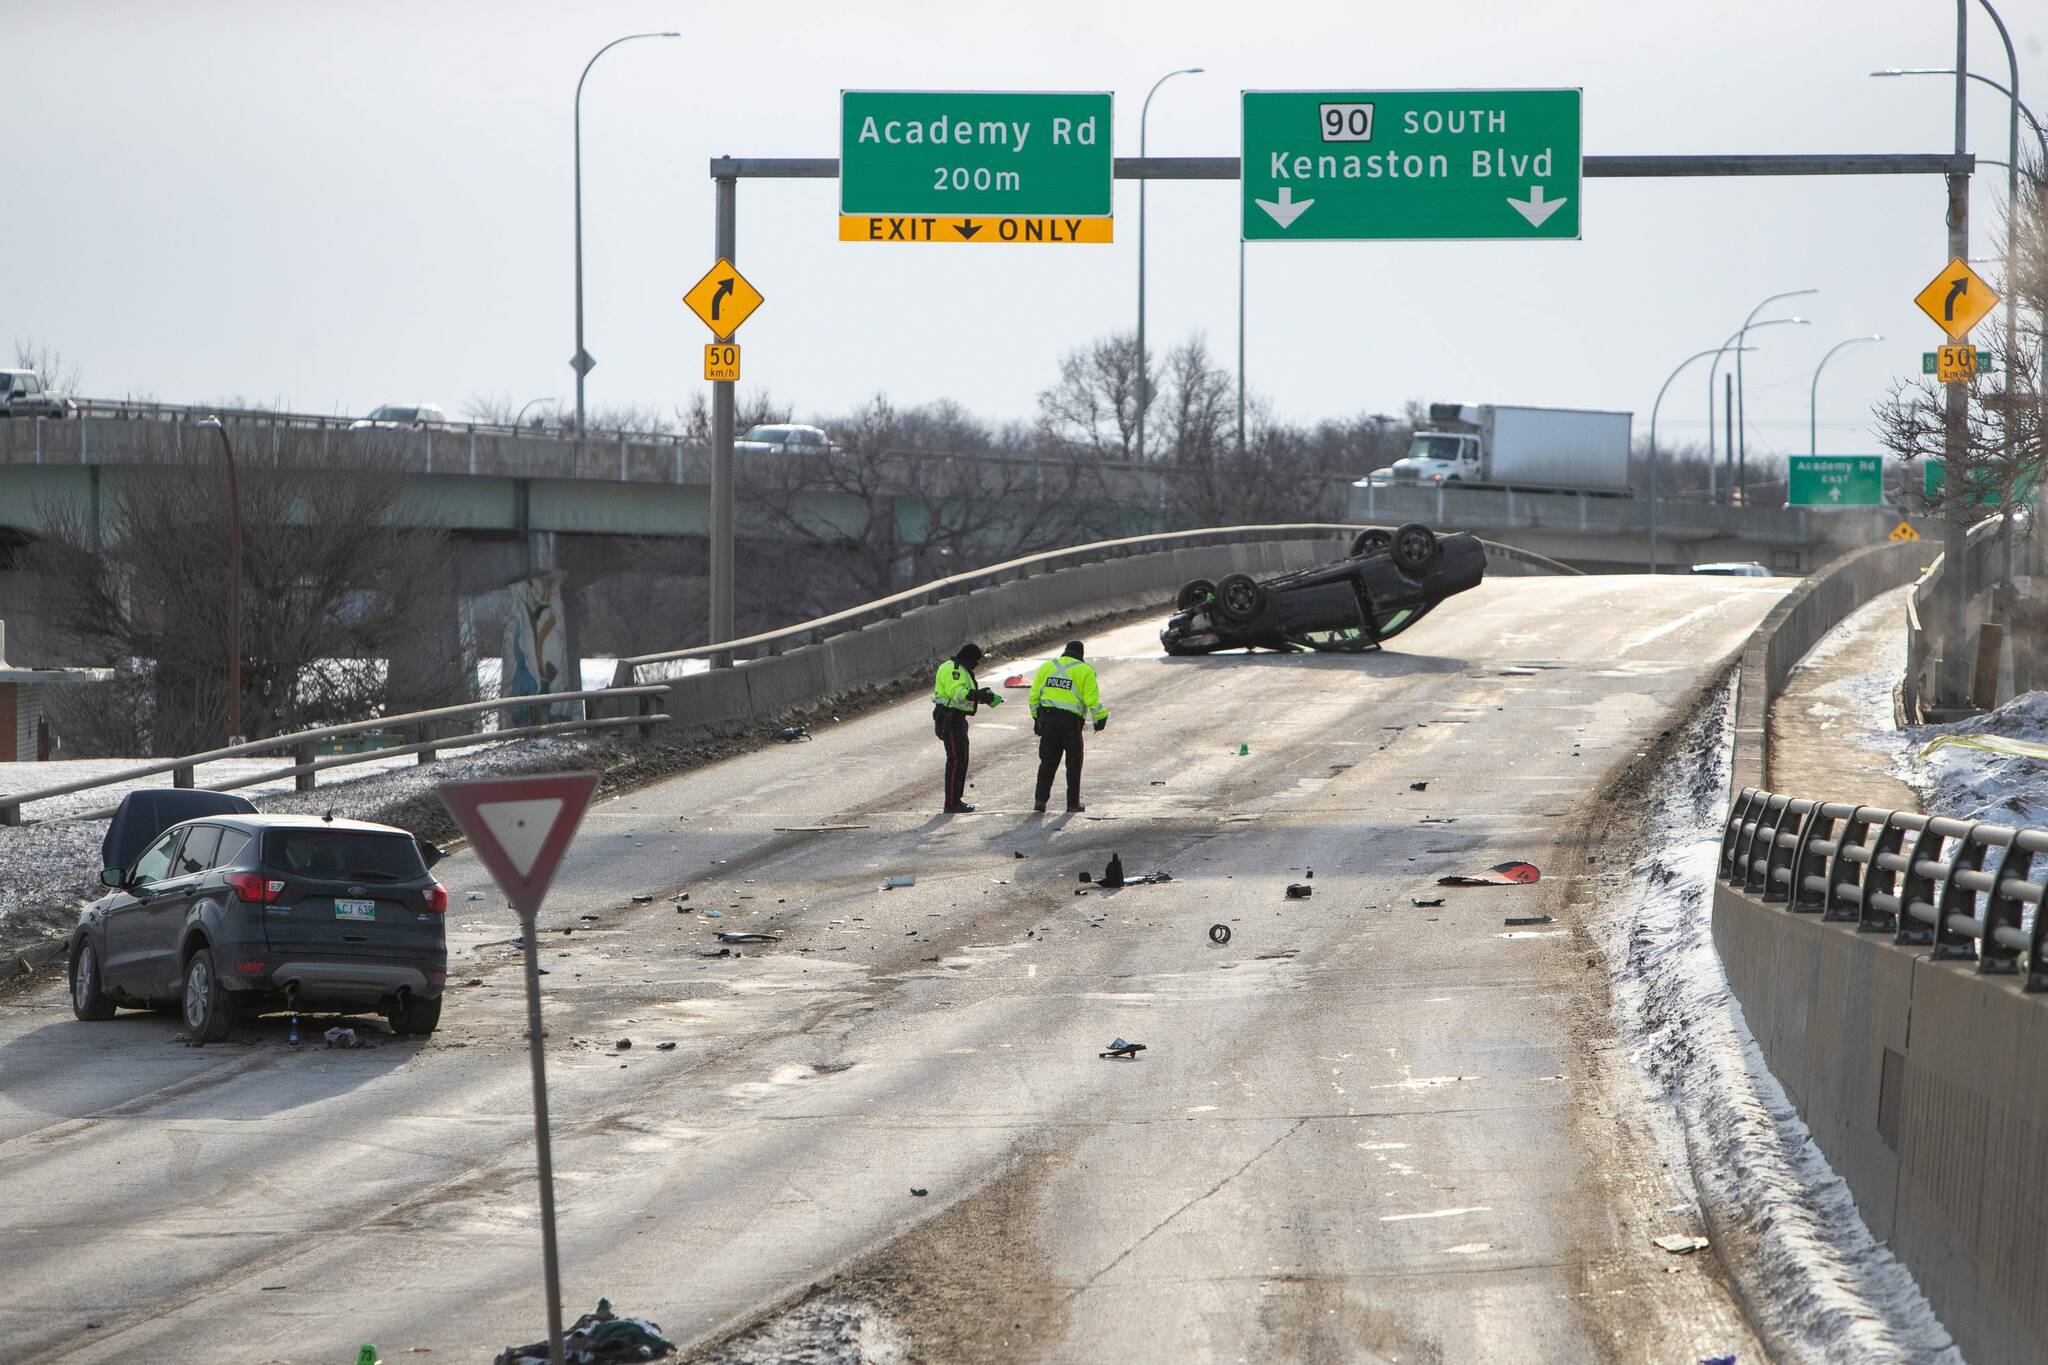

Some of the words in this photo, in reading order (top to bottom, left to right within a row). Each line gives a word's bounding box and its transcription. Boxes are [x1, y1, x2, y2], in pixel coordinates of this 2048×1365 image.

[1325, 108, 1368, 136] 90
[1404, 110, 1505, 134] SOUTH
[858, 115, 1030, 152] Academy
[1053, 115, 1096, 145] Rd
[1271, 150, 1448, 179] Kenaston
[1472, 147, 1552, 177] Blvd
[934, 167, 1020, 191] 200m
[869, 218, 936, 241] EXIT
[998, 218, 1082, 241] ONLY
[710, 347, 735, 366] 50
[1944, 348, 1969, 367] 50
[710, 368, 735, 377] km/h
[1797, 461, 1852, 473] Academy
[1858, 461, 1876, 472] Rd
[1822, 475, 1848, 484] EAST
[1047, 678, 1071, 690] POLICE
